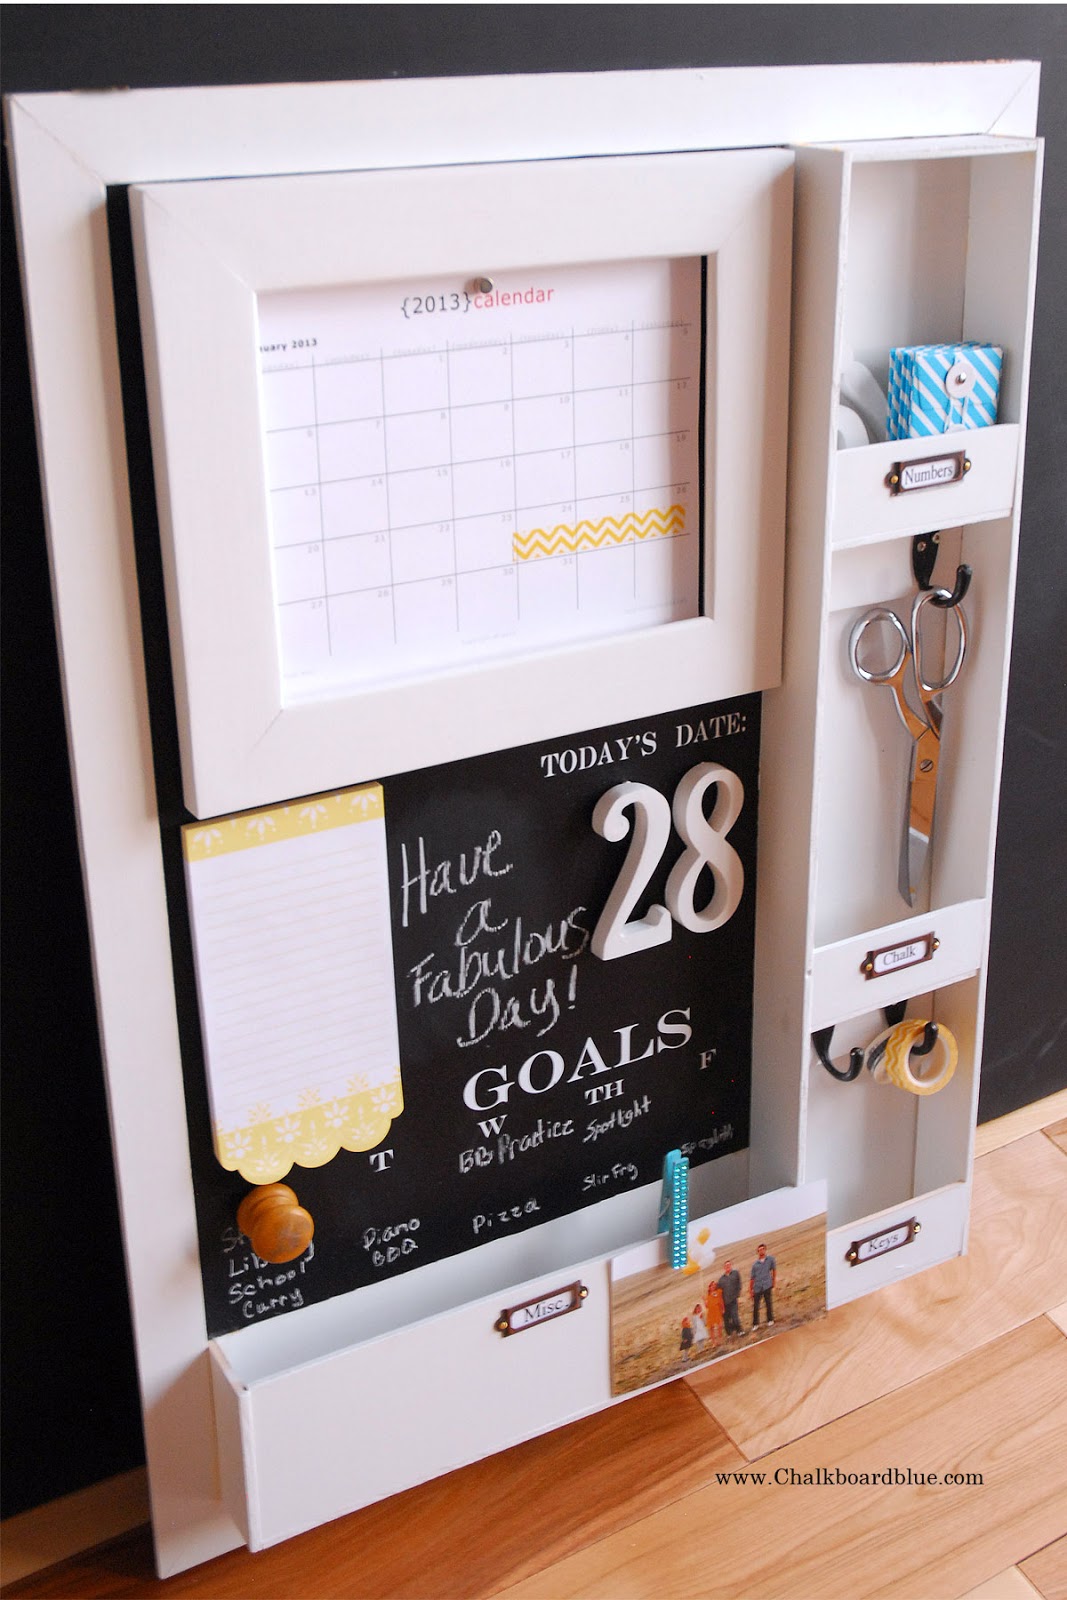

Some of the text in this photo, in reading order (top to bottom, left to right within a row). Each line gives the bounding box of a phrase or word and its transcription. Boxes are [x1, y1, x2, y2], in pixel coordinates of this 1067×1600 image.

[291, 337, 318, 349] 2013
[904, 464, 954, 486] Numbers
[540, 711, 747, 778] TODAY'S DATE:
[400, 829, 514, 928] Have
[591, 761, 745, 961] 28
[454, 898, 509, 947] a
[406, 906, 590, 1008] Fabulous
[882, 945, 917, 966] Chalk
[456, 964, 578, 1048] Day!
[462, 1007, 693, 1112] GOALS
[369, 1048, 717, 1173] T W TH F
[582, 1094, 652, 1143] Spotlight
[611, 1163, 639, 1181] Fry
[472, 1198, 541, 1235] Pizza
[868, 1234, 899, 1253] Keys
[242, 1288, 305, 1318] Curry
[524, 1299, 569, 1323] Misc.
